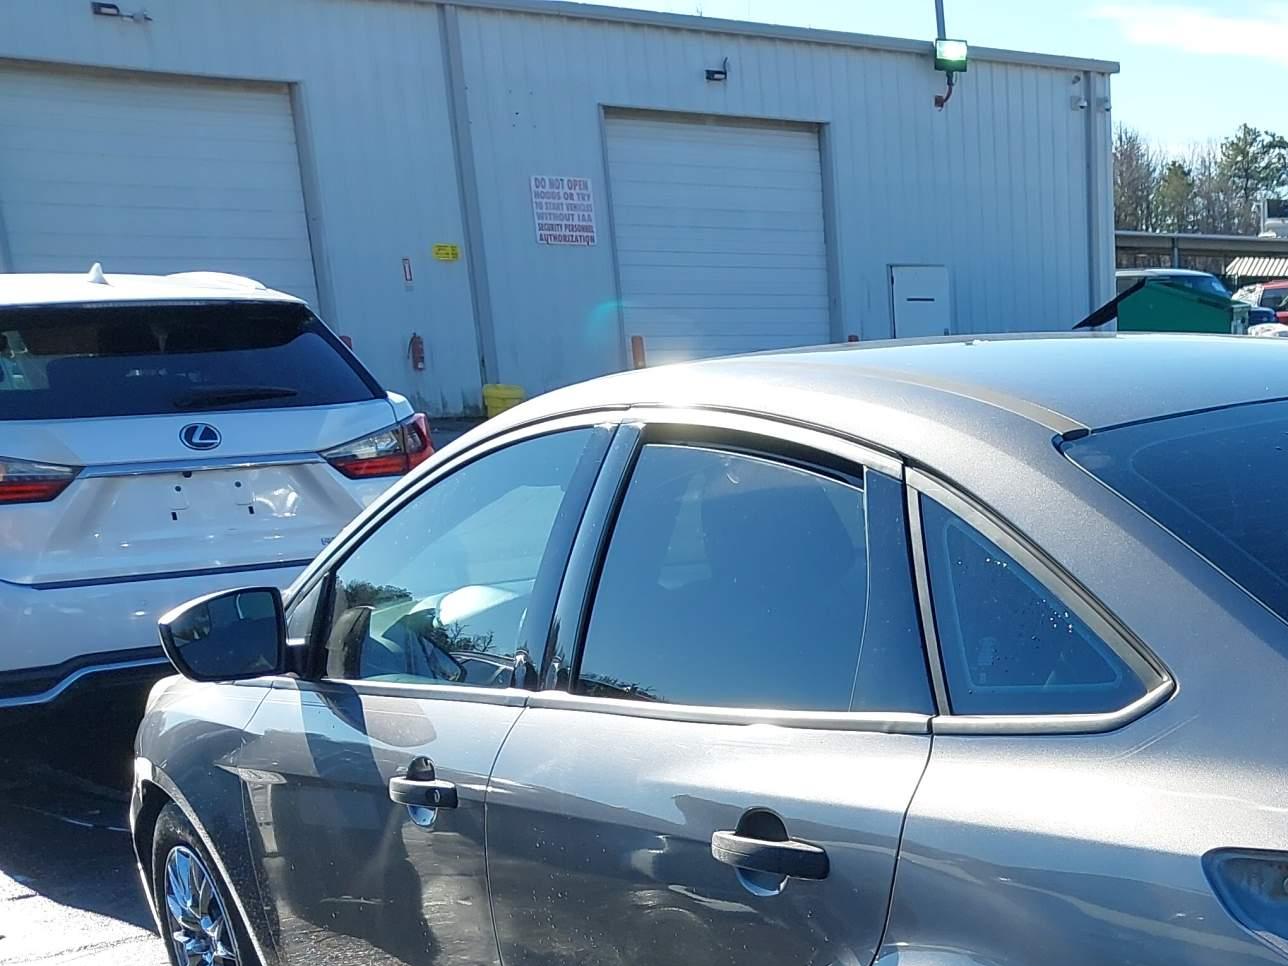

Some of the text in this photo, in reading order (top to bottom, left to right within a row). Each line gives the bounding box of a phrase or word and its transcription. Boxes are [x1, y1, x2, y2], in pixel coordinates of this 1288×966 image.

[534, 177, 589, 191] DO NOT OPEN
[534, 190, 591, 201] HOODS OR TRY
[535, 201, 593, 212] TO START VEHICLES
[536, 212, 593, 223] WITHOUT IAA
[538, 223, 594, 233] SECURITY PERSONNEL
[539, 232, 595, 244] AUTHORIZATION
